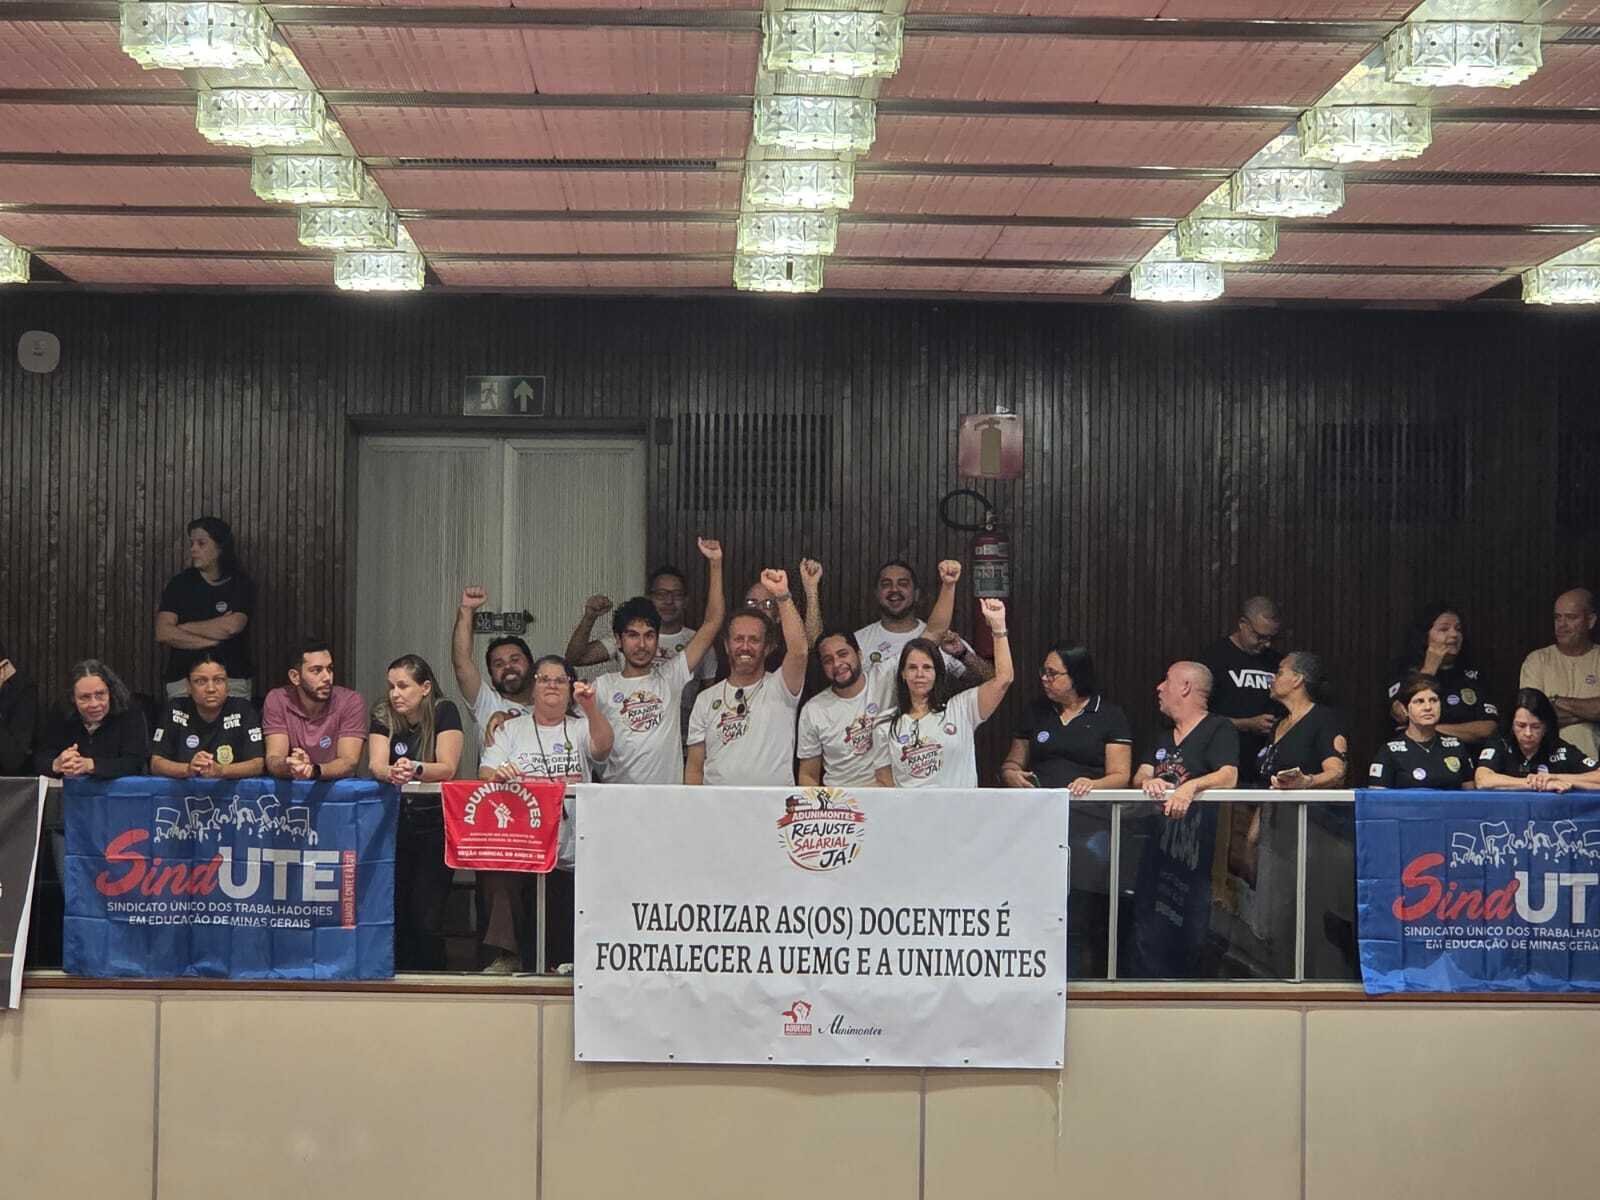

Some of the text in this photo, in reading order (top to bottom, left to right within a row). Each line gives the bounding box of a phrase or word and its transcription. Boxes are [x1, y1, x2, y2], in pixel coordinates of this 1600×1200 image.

[1228, 669, 1276, 689] VAN
[224, 720, 241, 730] CIVIL
[464, 782, 541, 828] ADUNIMONTES
[791, 811, 856, 821] ADUNIMONTES
[791, 823, 856, 840] REAJUSTE
[793, 836, 849, 853] SALARIAL
[107, 900, 333, 916] SINDICATO ÚNICO DOS TRABALHADORES
[129, 913, 311, 928] EM EDUCAÇÃO DE MINAS GERAIS
[632, 900, 1011, 940] VALORIZAR AS(OS) DOCENTES É
[1404, 926, 1464, 937] SINDICATO
[1466, 924, 1504, 937] ÚNICO
[1506, 926, 1530, 937] DOS
[1425, 940, 1442, 950] EM
[1445, 938, 1508, 951] EDUCAÇÃO
[1511, 940, 1527, 950] DE
[1529, 940, 1567, 951] MINAS
[595, 942, 1047, 978] FORTALECER A UEMG E A UNIMONTES
